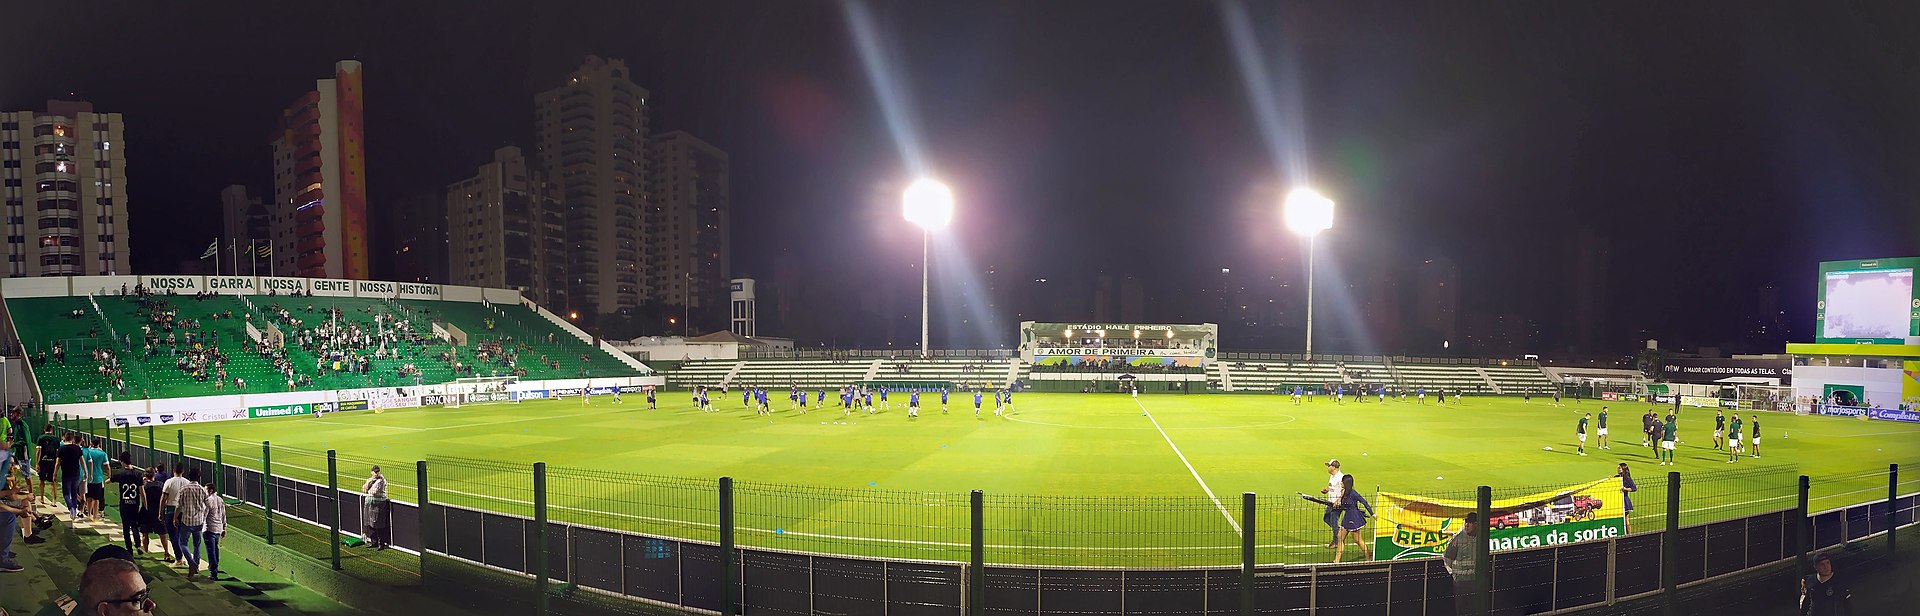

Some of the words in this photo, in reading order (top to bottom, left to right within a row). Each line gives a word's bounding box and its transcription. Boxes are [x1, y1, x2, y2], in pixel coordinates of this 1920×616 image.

[150, 278, 195, 289] NOSSA
[210, 279, 253, 289] GARRA
[264, 279, 303, 290] NOSSA
[314, 281, 350, 291] GENTE
[360, 282, 393, 293] NOSSA
[1701, 365, 1726, 374] CONTEÚDO
[1735, 367, 1751, 375] TODAS
[255, 405, 291, 416] Unimed
[122, 483, 138, 499] 23
[1396, 526, 1449, 545] REAL
[1546, 529, 1568, 545] da
[1574, 524, 1618, 542] sorte
